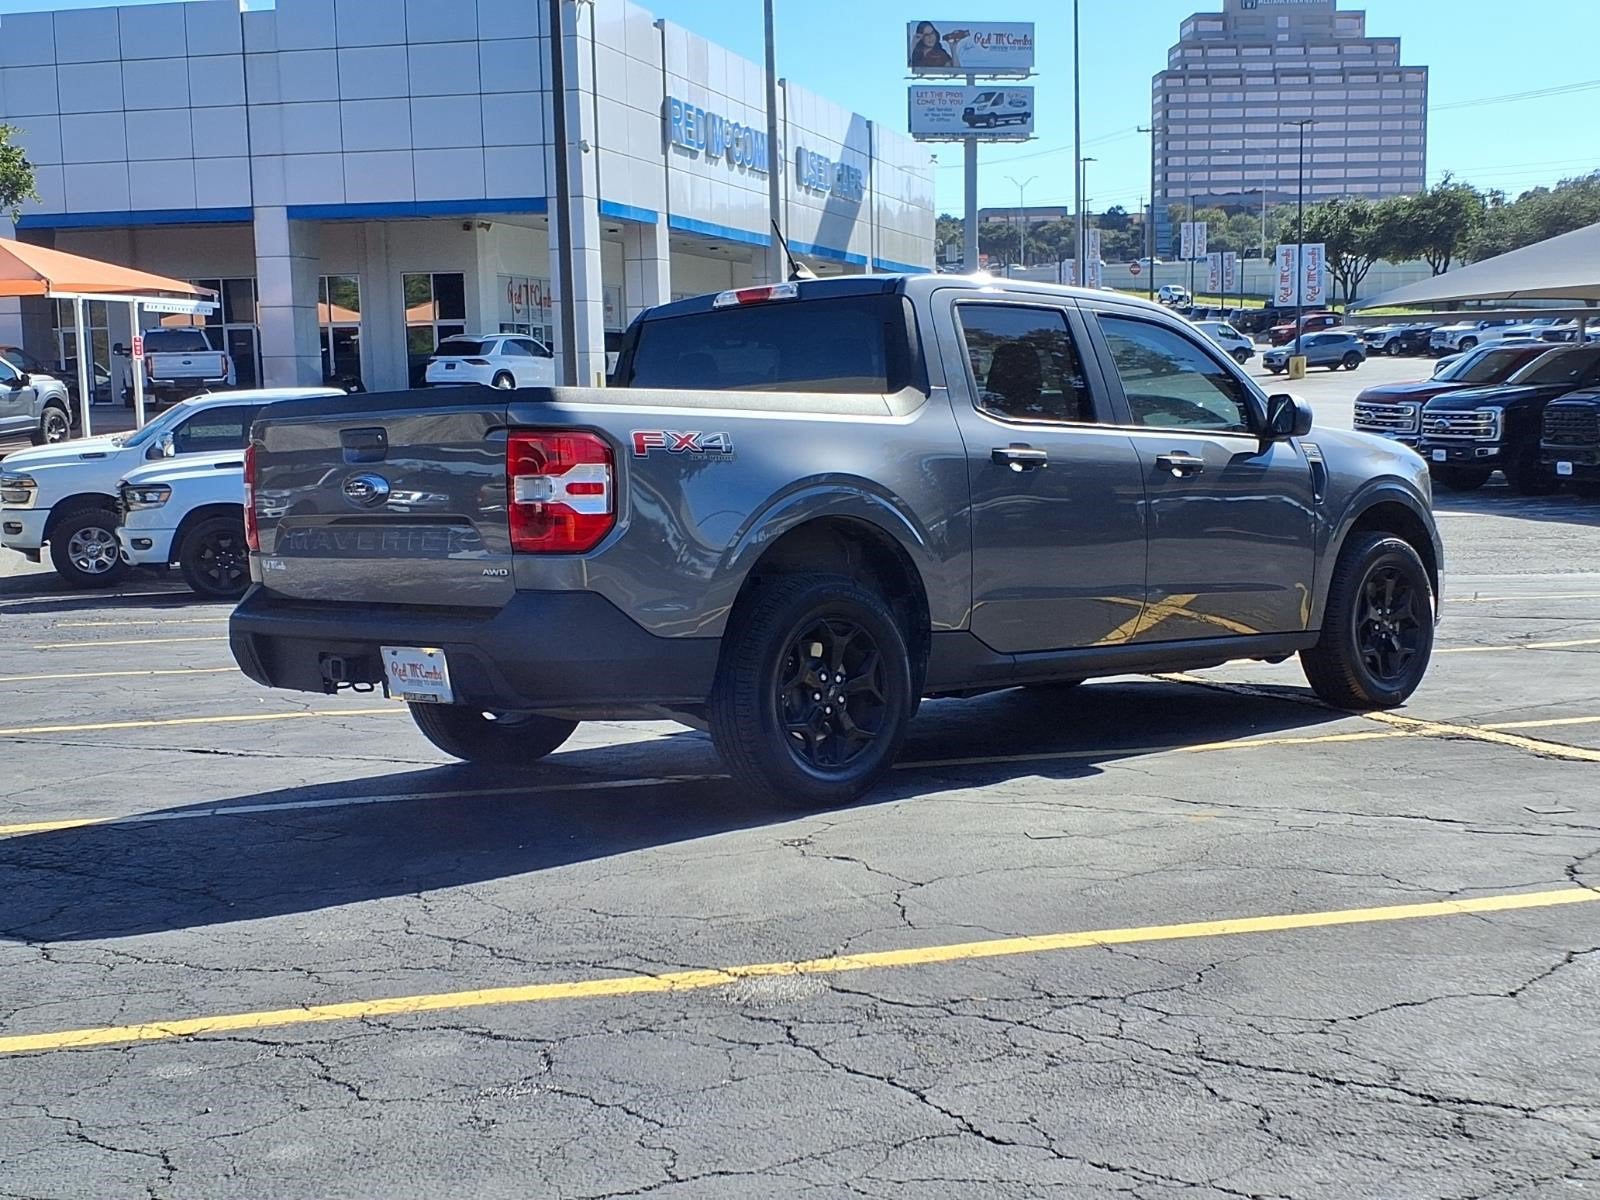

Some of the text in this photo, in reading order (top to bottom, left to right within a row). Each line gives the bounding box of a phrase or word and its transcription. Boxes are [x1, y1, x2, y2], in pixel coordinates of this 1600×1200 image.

[974, 32, 991, 49] Red
[665, 96, 706, 150] RED
[796, 146, 831, 192] USED
[630, 429, 734, 459] FX4
[288, 530, 469, 552] MAVERICK
[481, 568, 509, 577] AWD
[391, 661, 407, 681] Red
